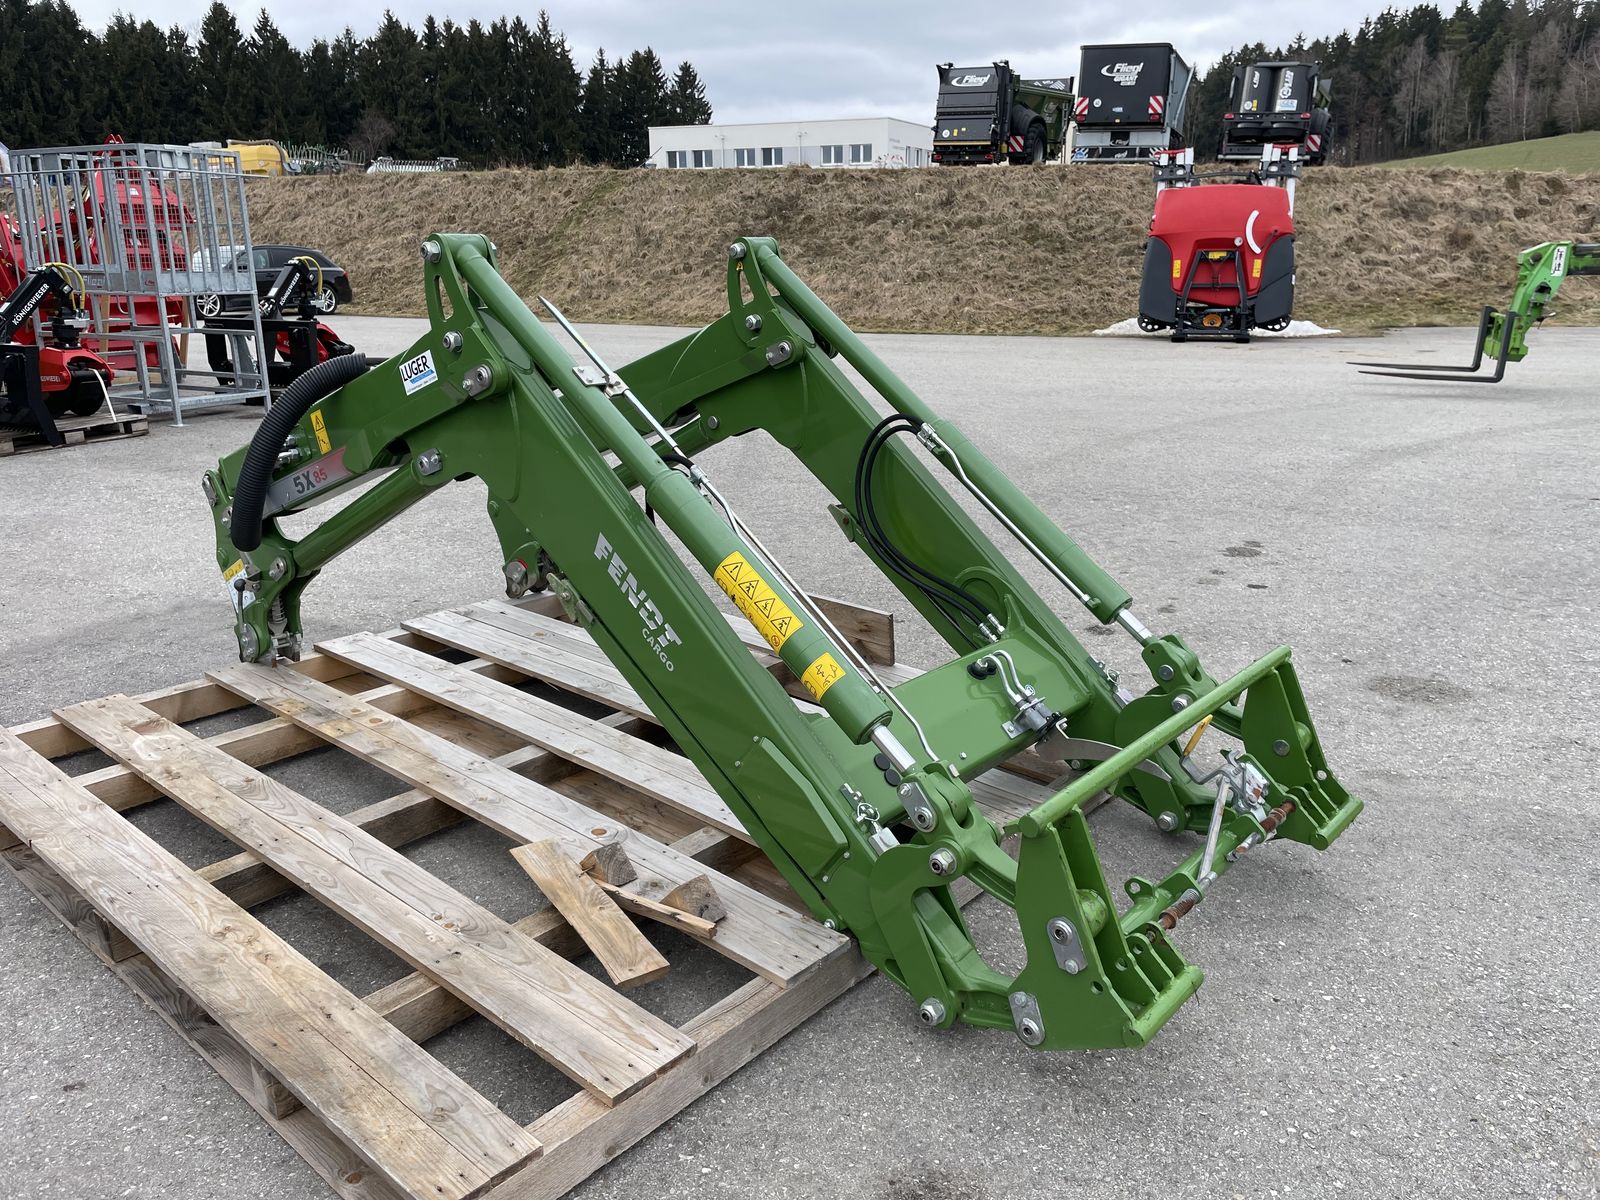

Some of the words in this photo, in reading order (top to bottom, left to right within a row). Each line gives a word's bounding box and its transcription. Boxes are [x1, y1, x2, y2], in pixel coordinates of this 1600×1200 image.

[962, 74, 991, 85] Fliegl
[1113, 62, 1144, 74] Fliegl
[279, 272, 300, 306] KÖNIGSWIESER
[11, 283, 50, 326] KÖNIGSWIESER
[401, 355, 430, 382] LUGER
[293, 471, 316, 494] 5X
[312, 468, 328, 484] 85
[594, 532, 682, 647] FENDT
[641, 627, 675, 672] CARGO
